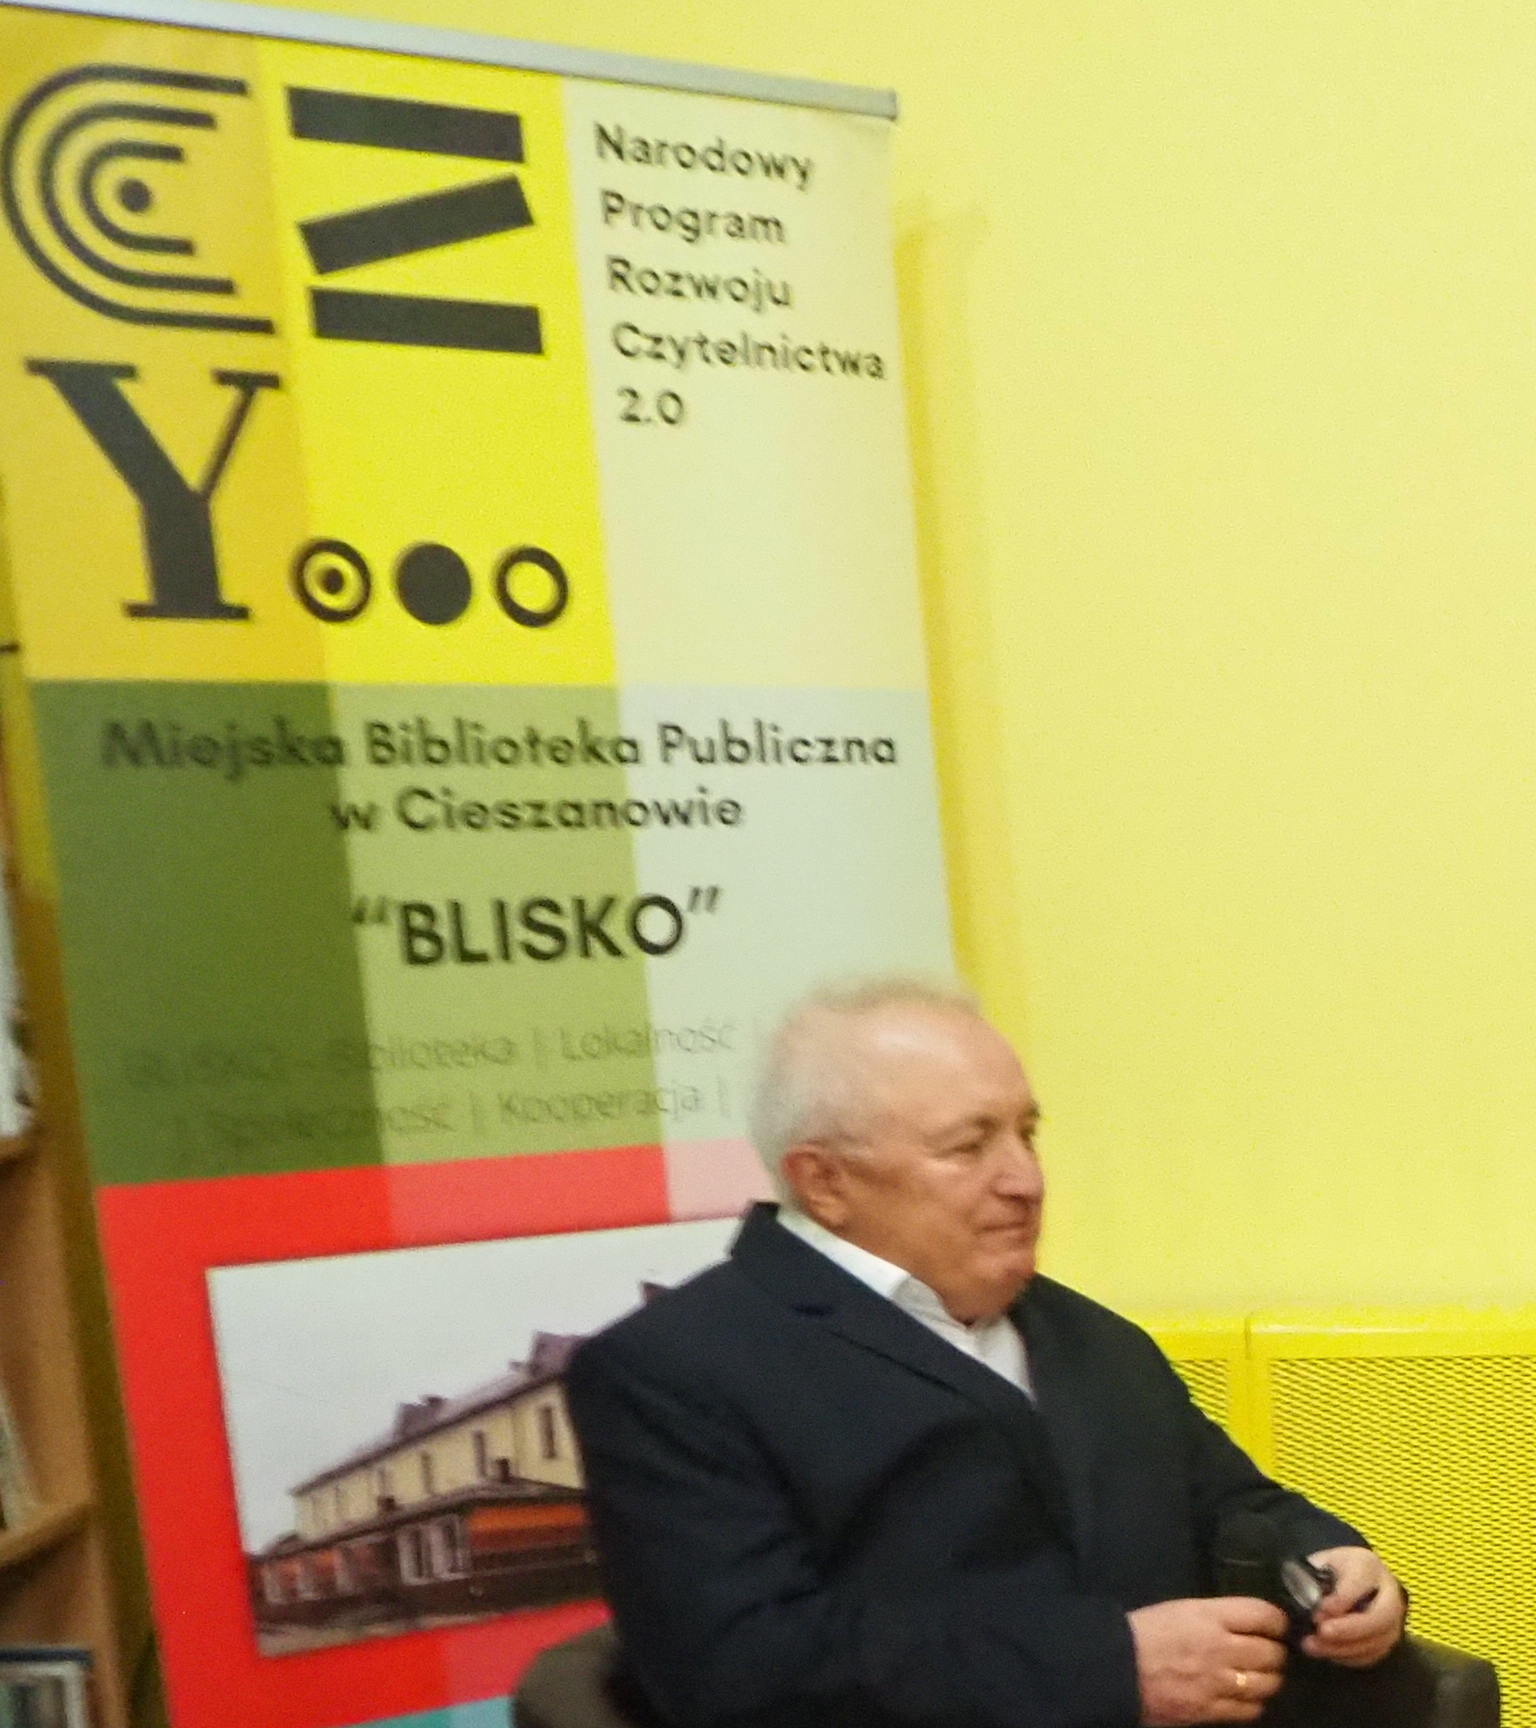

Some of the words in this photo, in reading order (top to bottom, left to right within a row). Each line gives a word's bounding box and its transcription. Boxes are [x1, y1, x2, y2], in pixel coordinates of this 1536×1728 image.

[593, 119, 813, 191] Narodowy
[600, 188, 787, 244] Program
[606, 253, 793, 314] Rozwoju
[612, 321, 887, 380] Czytelnictwa
[615, 385, 686, 427] 2.0
[100, 714, 346, 783] Miejska
[366, 716, 642, 767] Biblioteka
[658, 717, 899, 766] Publiczna
[330, 801, 375, 831] w
[399, 784, 744, 832] Cieszanowie
